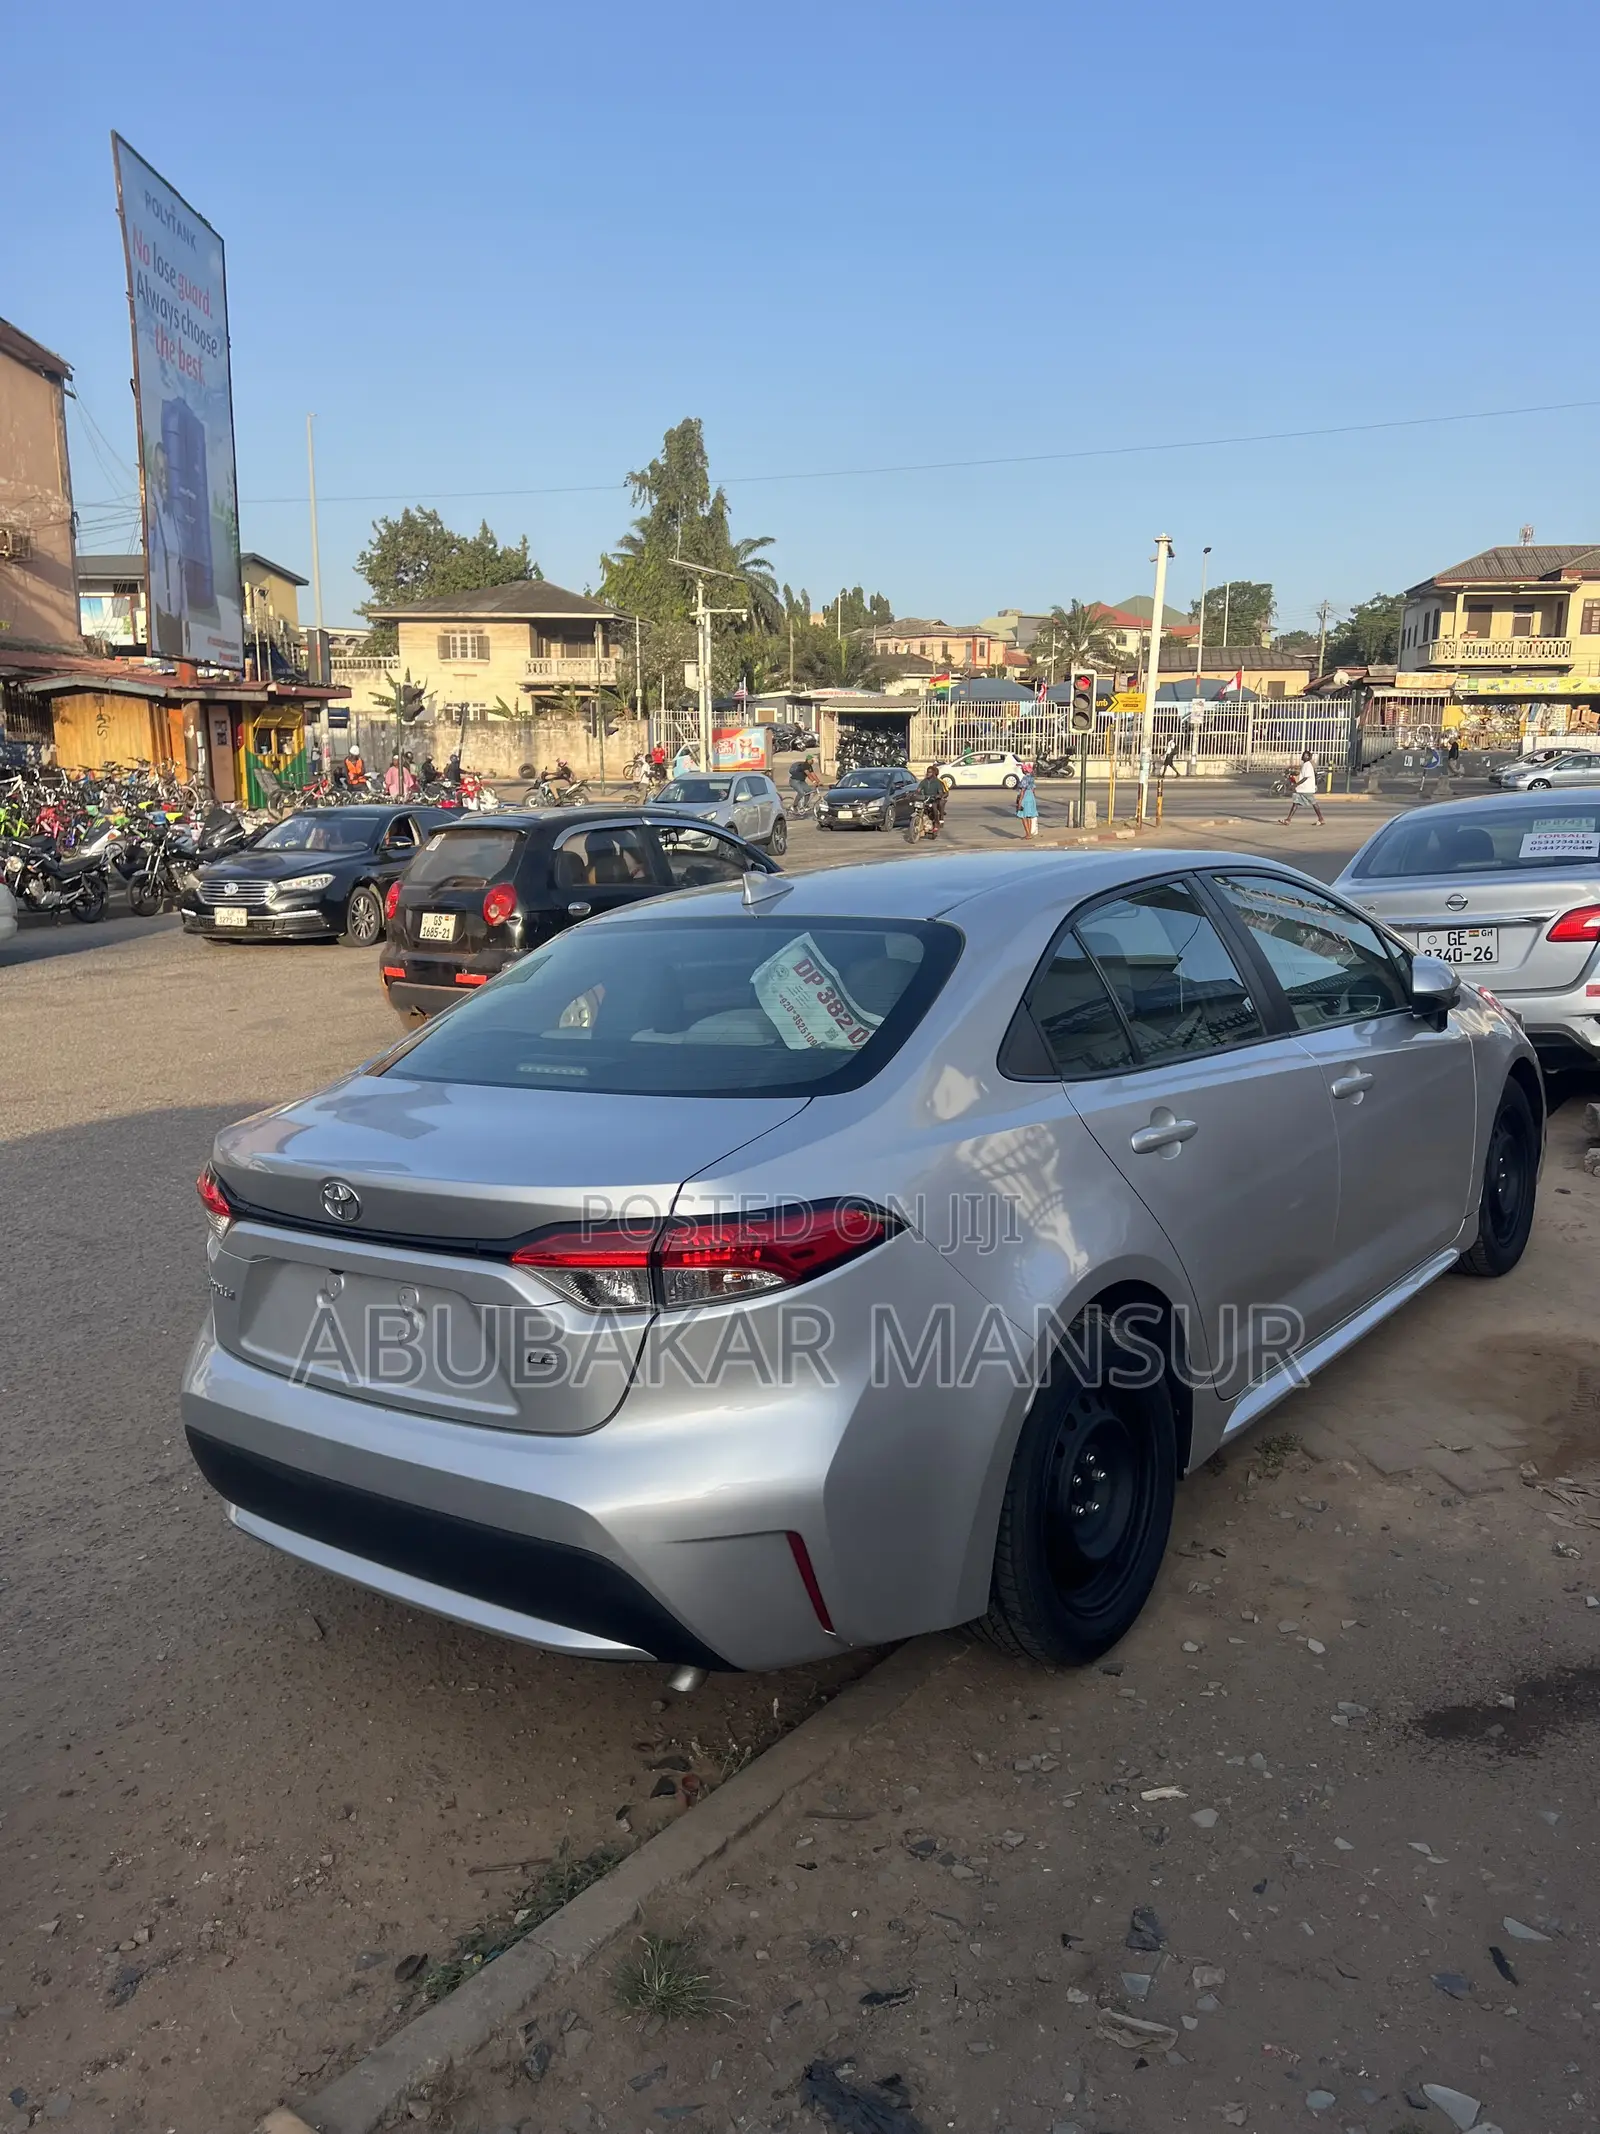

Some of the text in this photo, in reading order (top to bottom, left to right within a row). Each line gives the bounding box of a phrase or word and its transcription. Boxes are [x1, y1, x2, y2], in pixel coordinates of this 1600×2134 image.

[144, 190, 198, 252] POLYTANK
[133, 222, 213, 320] No lose guard.
[137, 269, 218, 359] Always choose
[155, 324, 175, 365] the
[422, 926, 450, 939] 1685-21
[433, 915, 443, 927] GS
[1447, 929, 1493, 946] GE GH
[793, 958, 825, 986] DP
[817, 986, 854, 1031] 382
[848, 1026, 870, 1045] D
